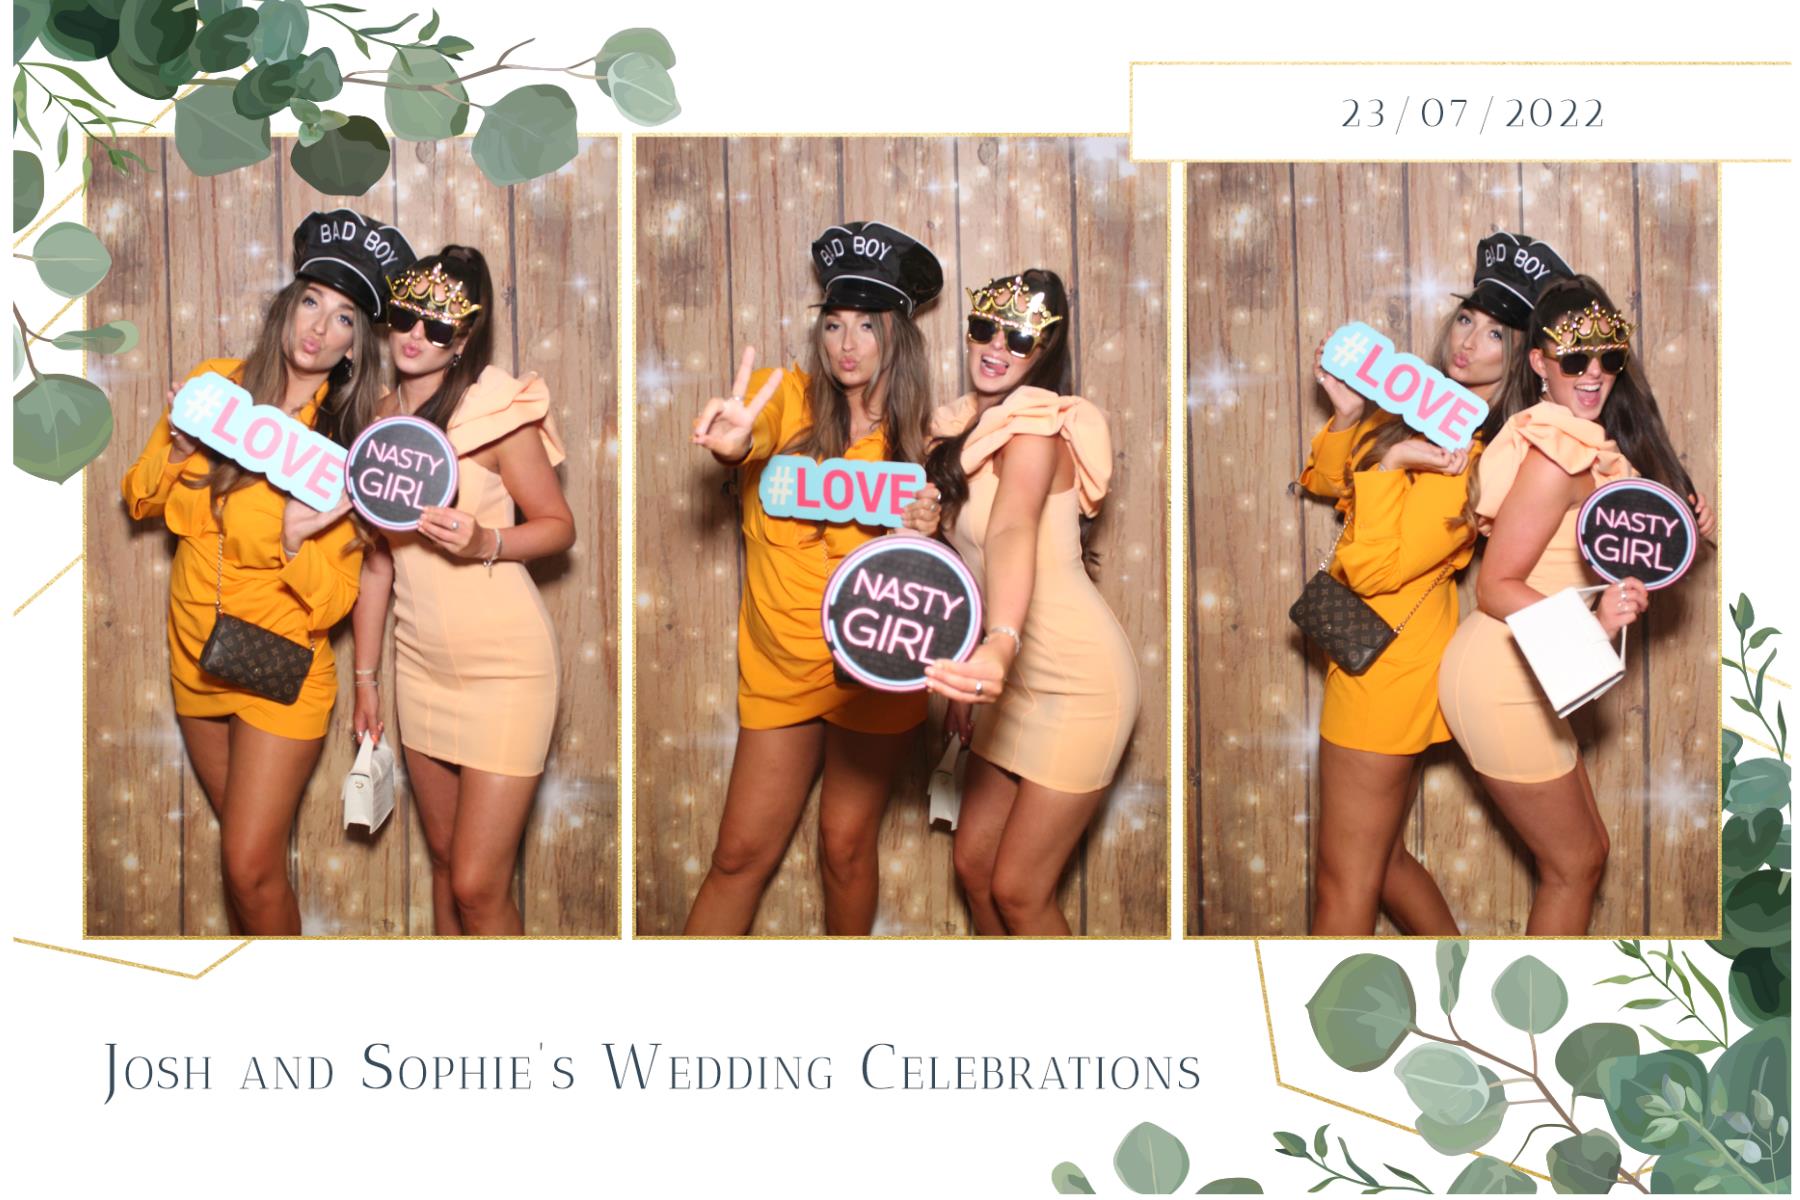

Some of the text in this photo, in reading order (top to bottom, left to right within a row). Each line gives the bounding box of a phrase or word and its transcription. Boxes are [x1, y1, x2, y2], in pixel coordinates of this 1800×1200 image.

[320, 220, 398, 266] BAD BOY
[852, 235, 892, 261] BOY
[1513, 247, 1551, 281] BOY
[1331, 330, 1480, 443] #LOVE
[183, 383, 346, 501] #LOVE
[365, 439, 445, 477] NASTY
[358, 467, 427, 511] GIRL
[767, 465, 917, 516] #LOVE
[1595, 506, 1680, 538] NASTY
[1594, 533, 1674, 572] GIRL
[852, 567, 965, 621] NASTY
[842, 607, 937, 666] GIRL
